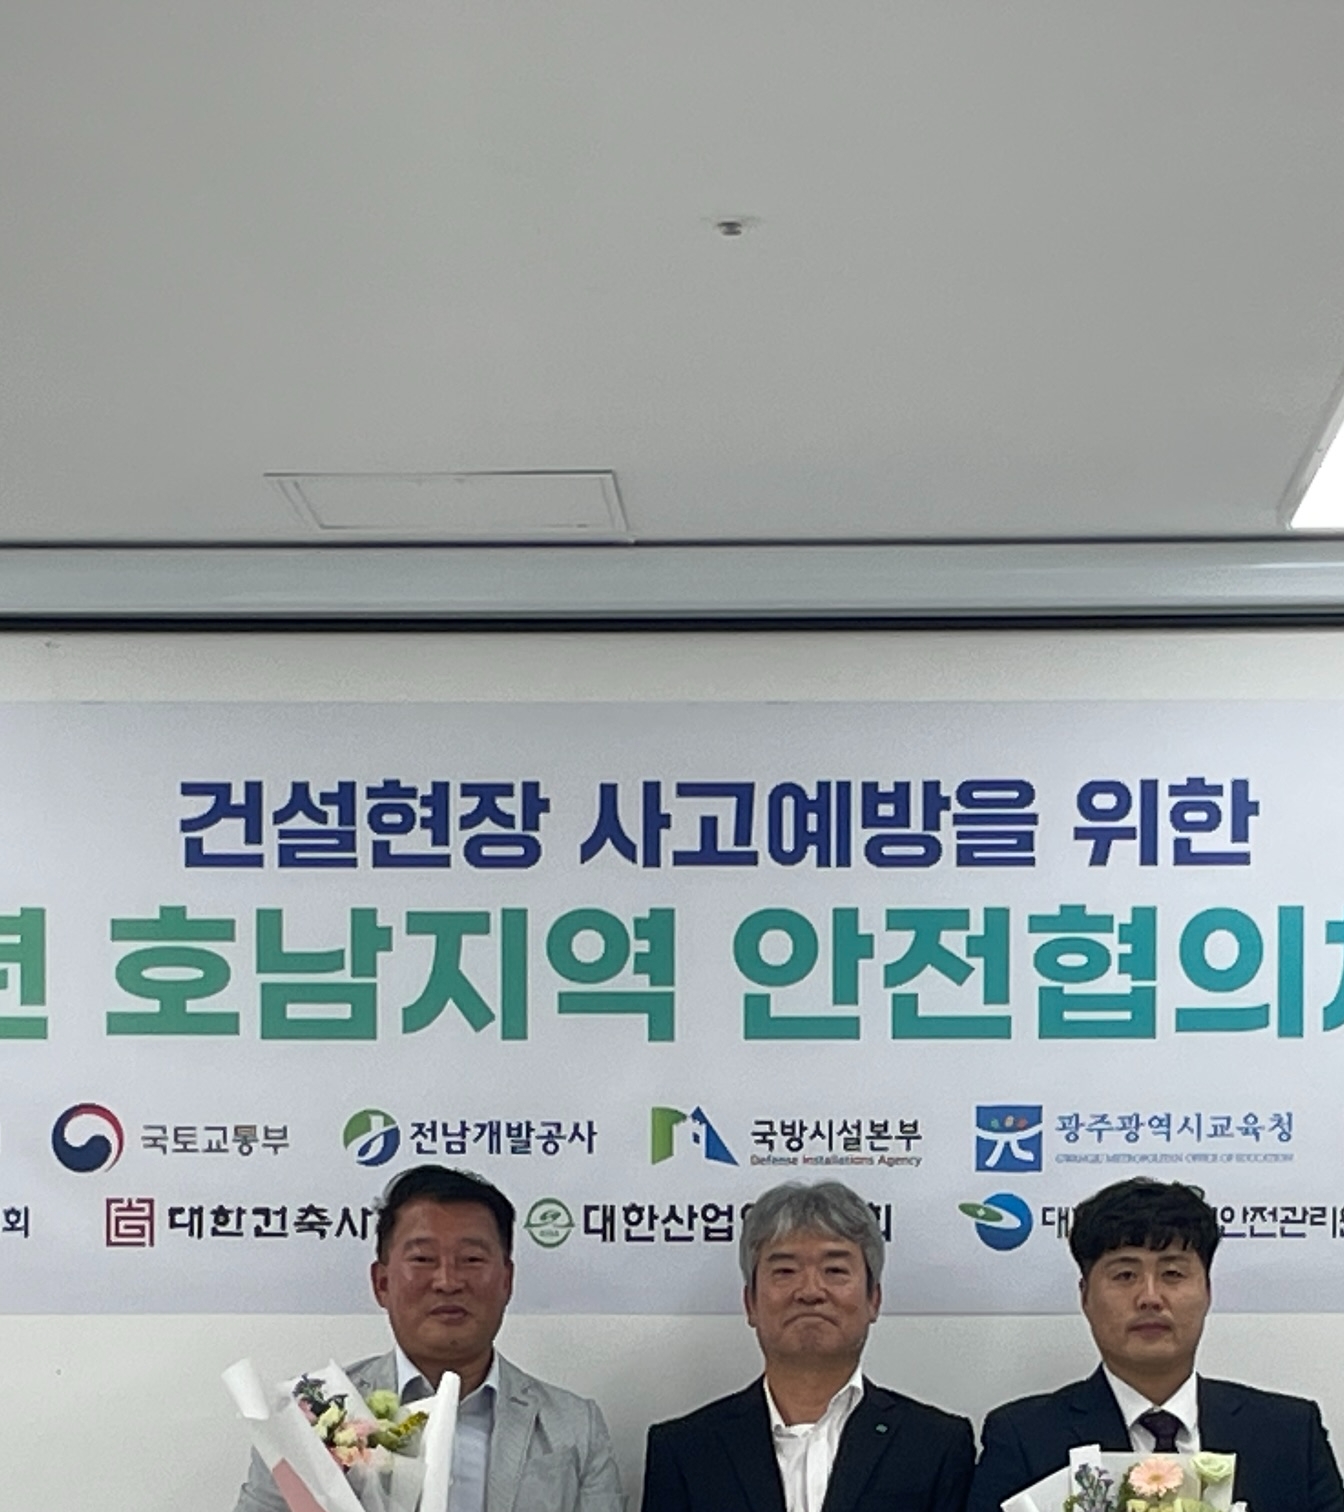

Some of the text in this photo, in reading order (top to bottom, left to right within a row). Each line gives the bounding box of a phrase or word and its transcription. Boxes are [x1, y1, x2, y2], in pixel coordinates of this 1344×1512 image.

[180, 776, 1260, 870] 건설현장 사고예방을 위한
[106, 905, 675, 1042] 호남지역
[141, 1125, 289, 1155] 국토교통부
[410, 1120, 598, 1155] 전남개발공사
[751, 1119, 922, 1152] 국방시설본부
[1055, 1112, 1293, 1143] 광주광역시교육청
[878, 1155, 922, 1167] Agency
[168, 1203, 378, 1241] 대한건축사
